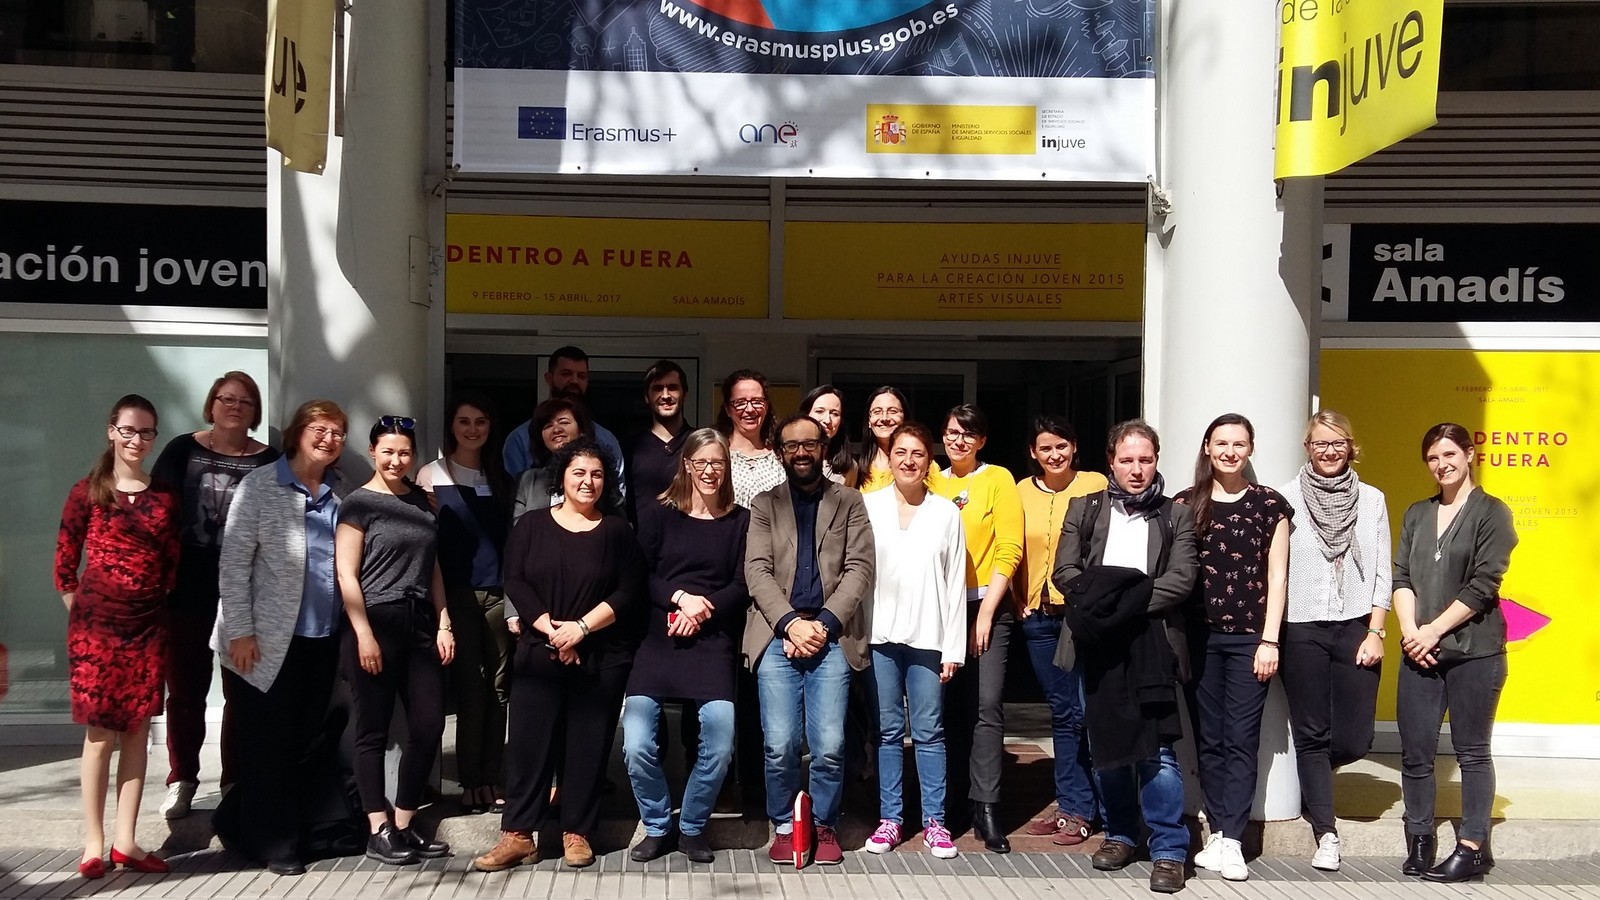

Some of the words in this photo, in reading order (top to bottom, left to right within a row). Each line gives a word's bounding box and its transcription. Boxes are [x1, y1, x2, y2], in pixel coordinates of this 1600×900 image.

[1282, 0, 1318, 24] de
[658, 0, 959, 62] www.erasmusplus.gob.es
[1276, 10, 1424, 136] injuve
[572, 123, 678, 143] Erasmus+
[1041, 135, 1086, 152] injuve
[447, 245, 563, 266] DENTRO
[572, 248, 590, 266] A
[602, 249, 693, 268] FUERA
[940, 253, 1000, 265] AYUDAS
[1007, 253, 1062, 265] INJUVE
[1373, 238, 1444, 262] sala
[135, 248, 267, 292] joven
[877, 272, 915, 284] PARA
[922, 273, 939, 284] LA
[946, 270, 1025, 285] CREACIÓN
[1032, 273, 1081, 285] JOVEN
[1089, 273, 1125, 285] 2015
[1372, 267, 1566, 303] Amadís
[472, 291, 479, 299] 9
[482, 291, 532, 301] FEBRERO
[543, 293, 555, 301] 15
[597, 294, 621, 303] 2017
[672, 295, 699, 305] SALA
[703, 295, 745, 306] AMADÍS
[938, 293, 985, 304] ARTES
[991, 293, 1062, 305] VISUALES
[1474, 431, 1568, 446] DENTRO
[1477, 453, 1550, 467] FUERA
